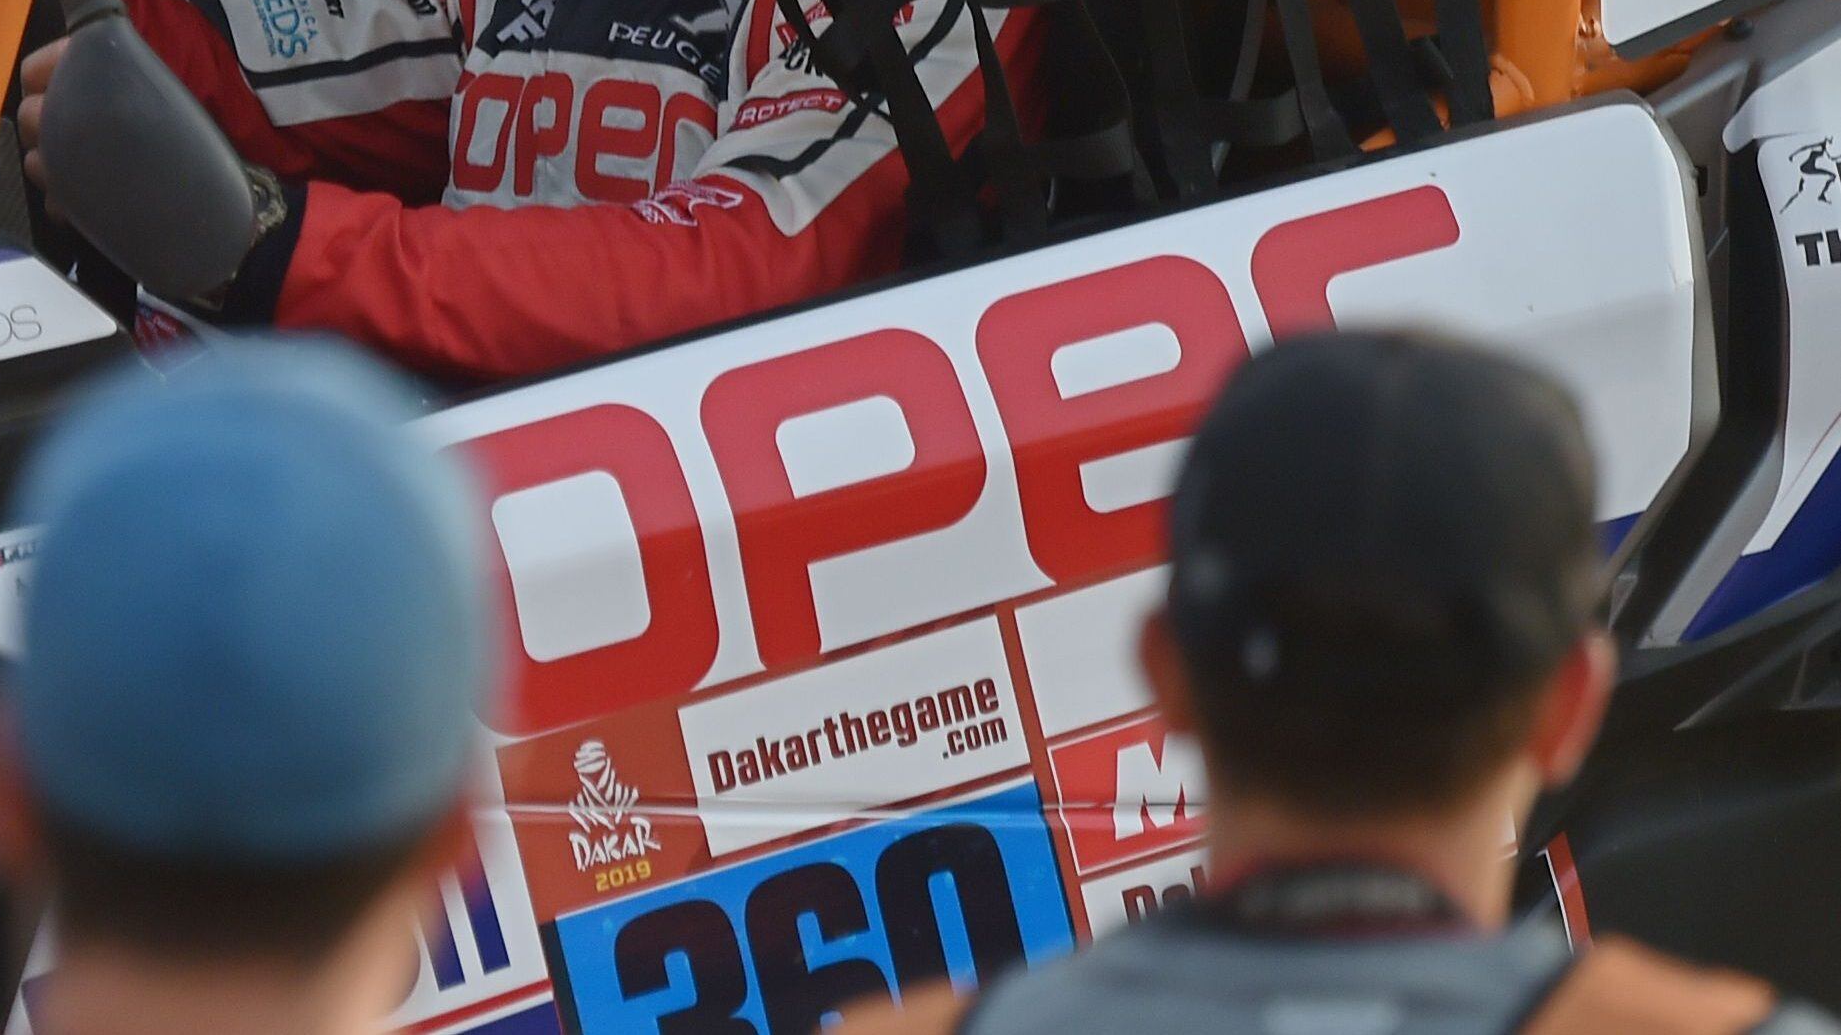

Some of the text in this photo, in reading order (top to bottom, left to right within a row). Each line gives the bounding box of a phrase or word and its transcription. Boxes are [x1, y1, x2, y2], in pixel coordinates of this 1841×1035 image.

[609, 21, 723, 85] PEUGE
[707, 678, 1000, 795] Dakarthegame
[943, 717, 1008, 760] .com
[1113, 731, 1208, 841] M
[569, 816, 661, 872] DAKAR
[595, 860, 651, 892] 2019
